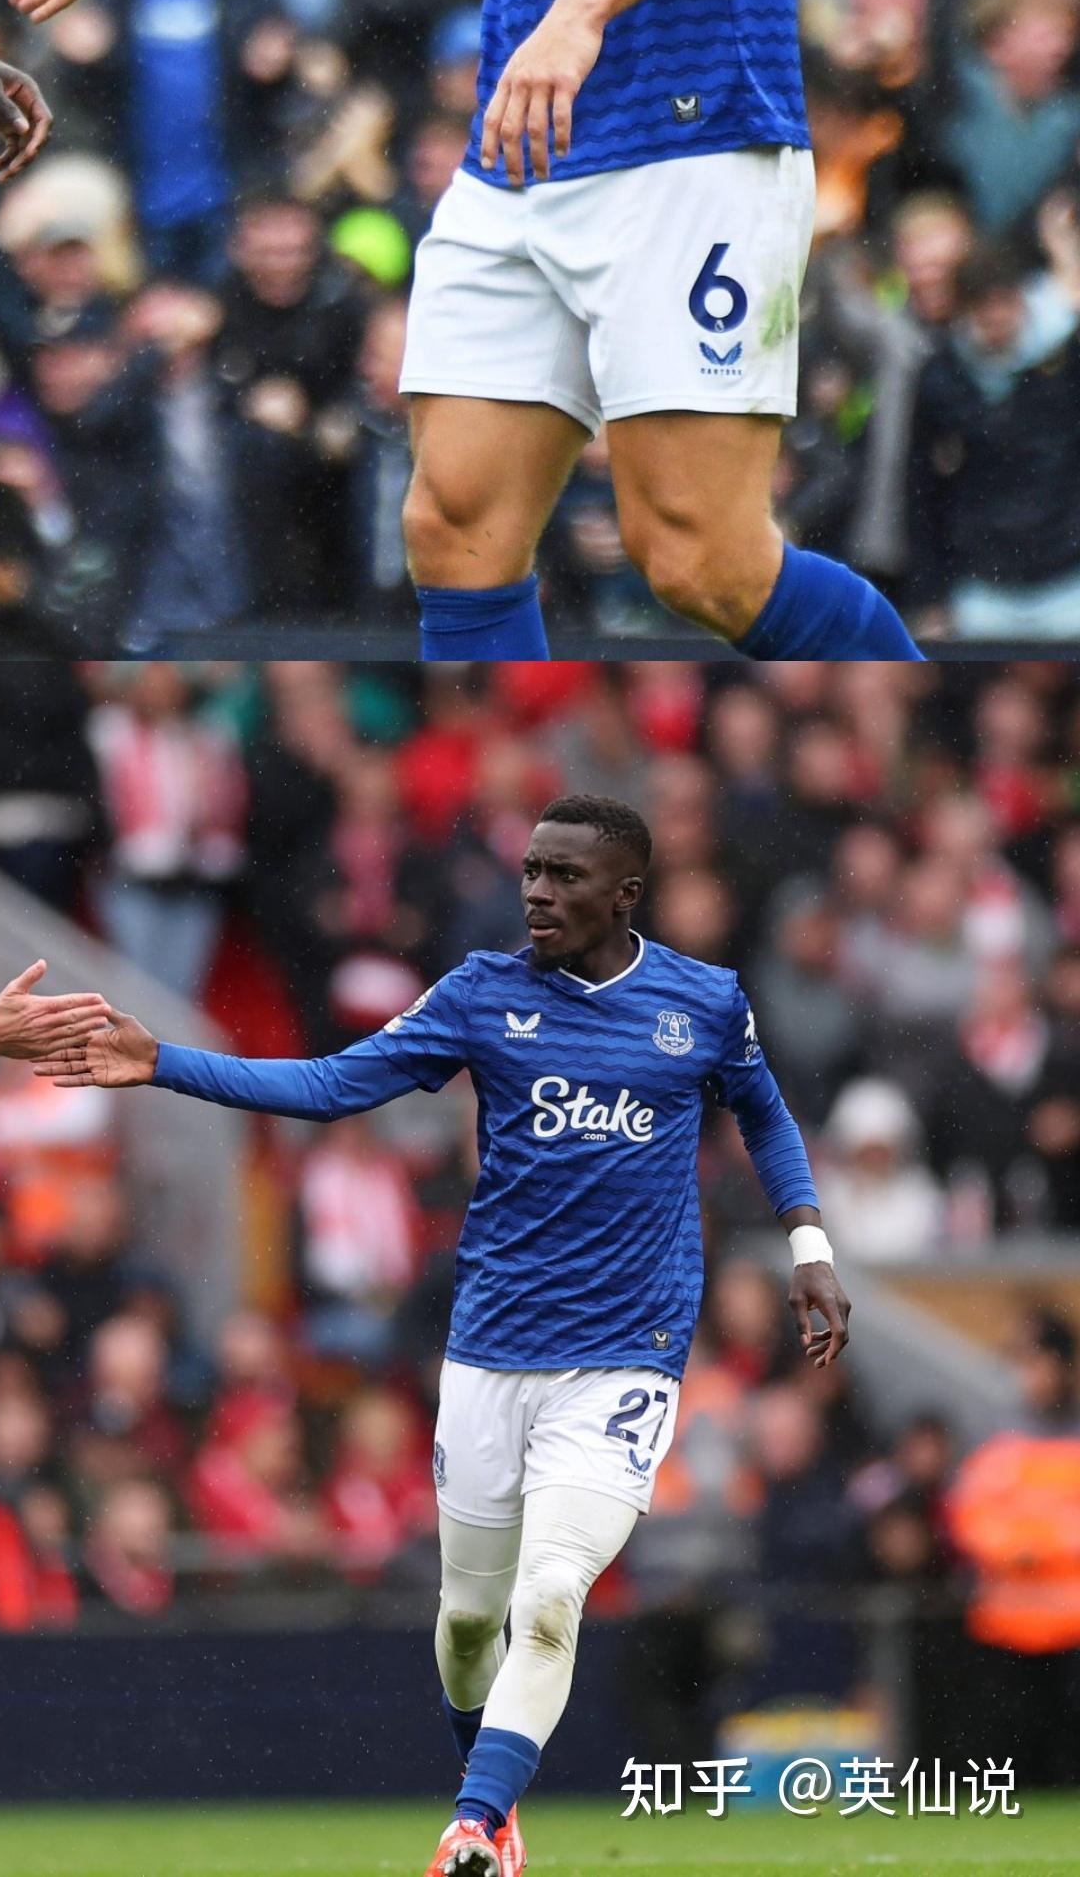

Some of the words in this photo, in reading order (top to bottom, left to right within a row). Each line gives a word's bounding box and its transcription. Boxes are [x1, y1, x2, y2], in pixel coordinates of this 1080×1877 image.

[688, 242, 749, 334] 6
[531, 1075, 655, 1143] Stake
[581, 1133, 608, 1142] .com
